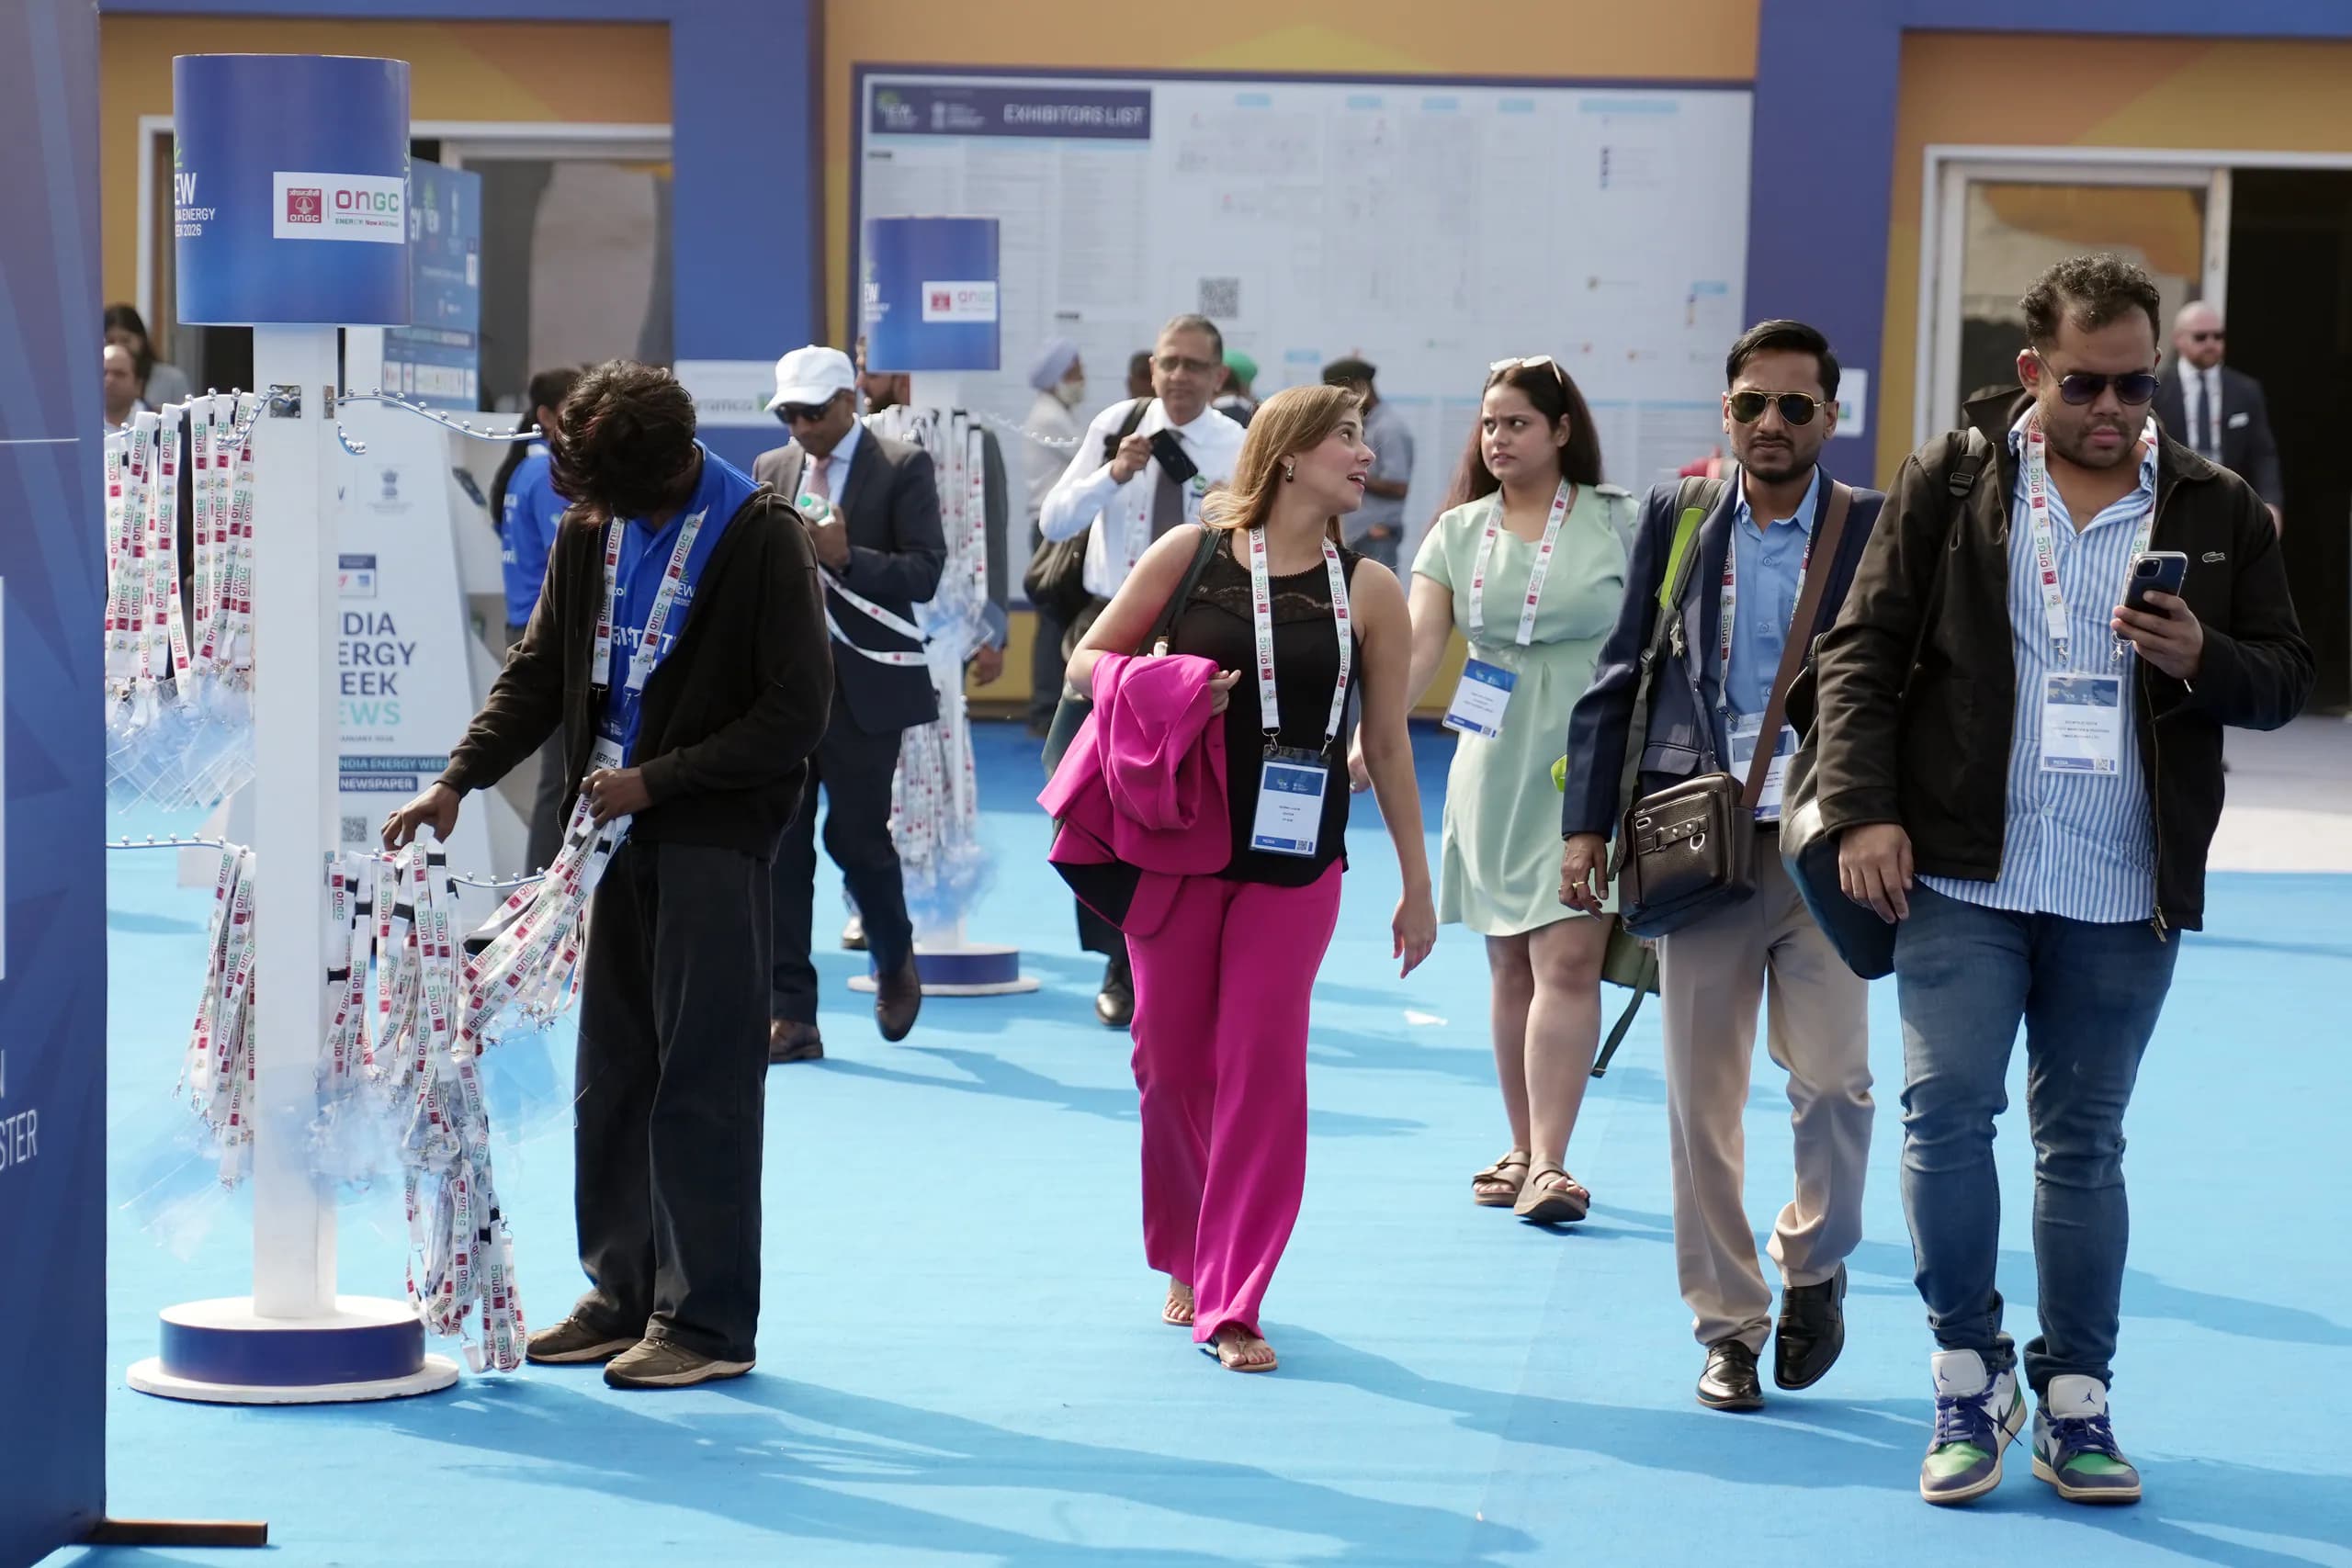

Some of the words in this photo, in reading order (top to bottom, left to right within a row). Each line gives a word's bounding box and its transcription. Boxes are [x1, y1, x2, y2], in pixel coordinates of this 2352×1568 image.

[1003, 104, 1102, 125] EXHIBITORS
[1105, 105, 1144, 125] LIST
[184, 223, 202, 237] 2026
[339, 778, 413, 790] NEWSPAPER
